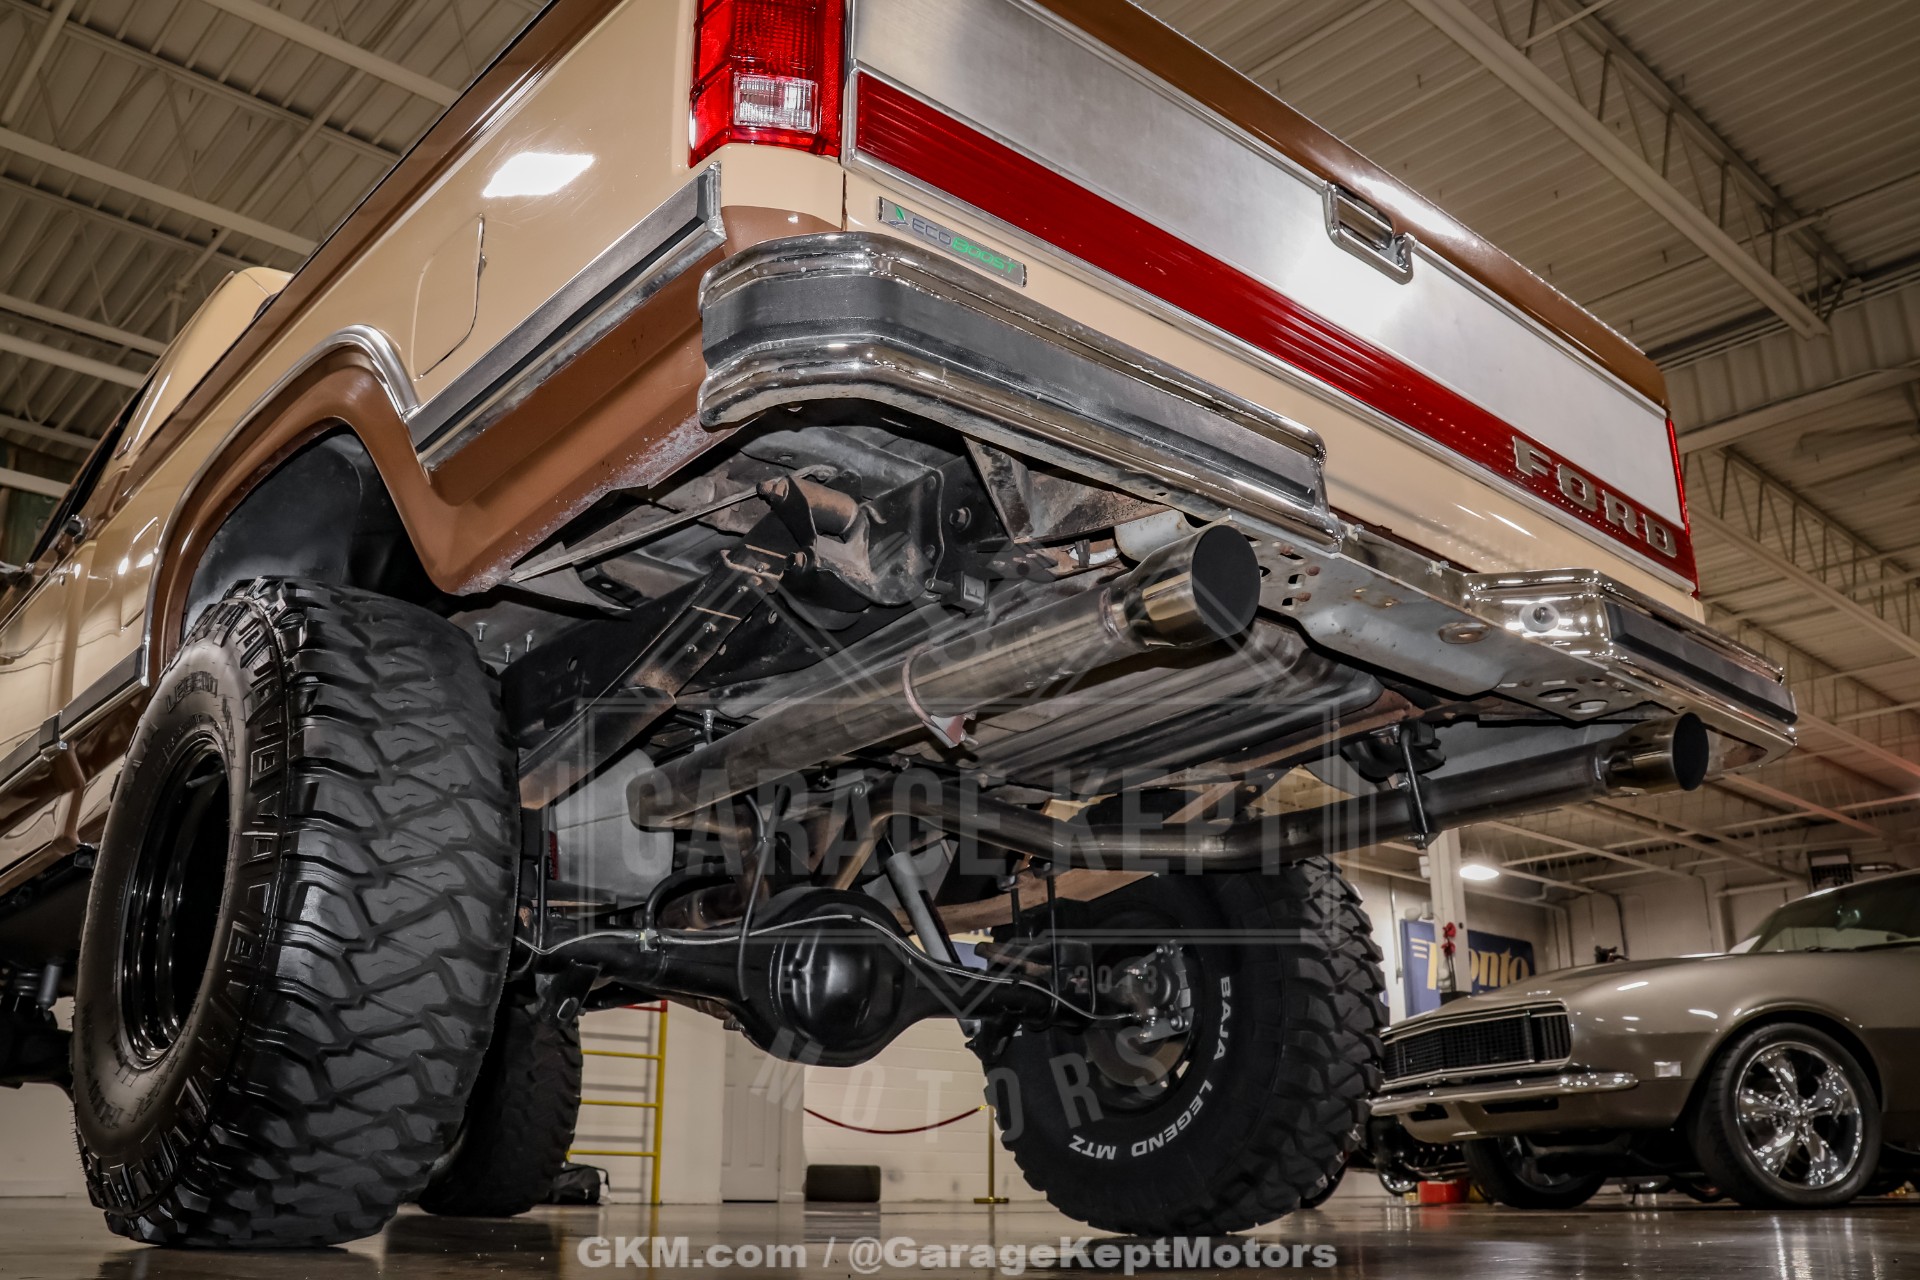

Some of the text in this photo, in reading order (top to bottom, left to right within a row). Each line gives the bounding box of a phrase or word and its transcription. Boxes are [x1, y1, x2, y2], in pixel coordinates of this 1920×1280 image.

[911, 217, 1017, 274] ECOBOOST
[1511, 435, 1677, 558] FORD
[1426, 941, 1530, 990] onto
[1068, 976, 1232, 1160] BAJA LEGEND MTZ
